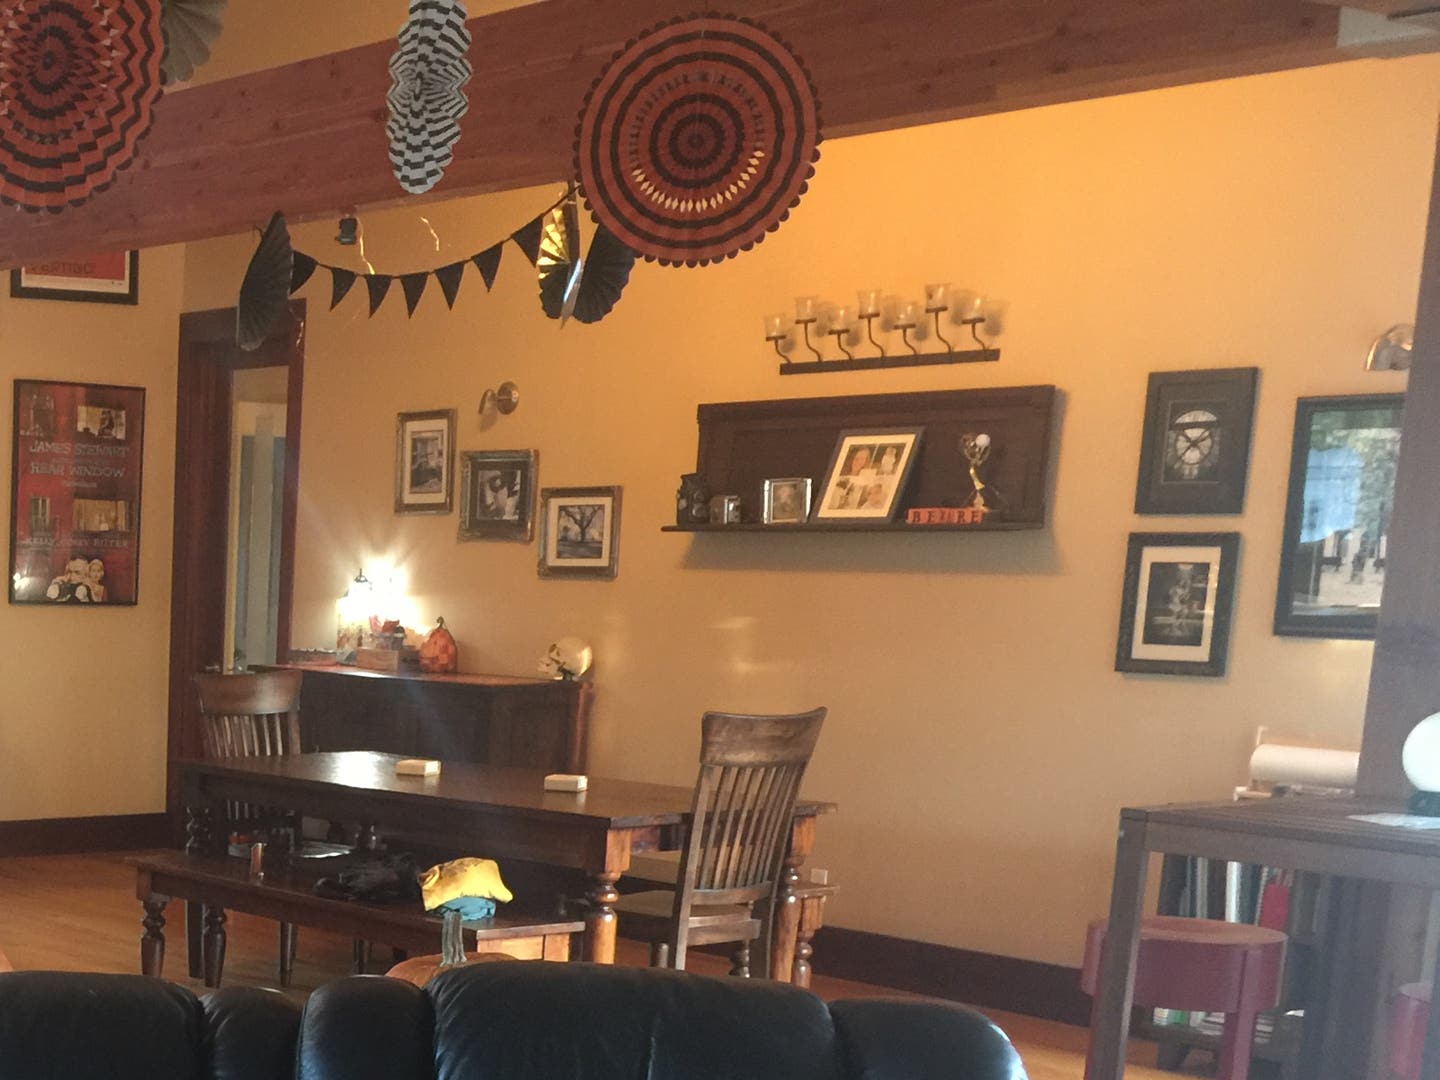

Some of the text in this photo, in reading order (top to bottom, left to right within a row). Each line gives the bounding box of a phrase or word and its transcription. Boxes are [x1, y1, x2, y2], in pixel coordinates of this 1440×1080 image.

[29, 440, 129, 458] JAMES STEWART
[31, 462, 127, 478] REAR WINDOW
